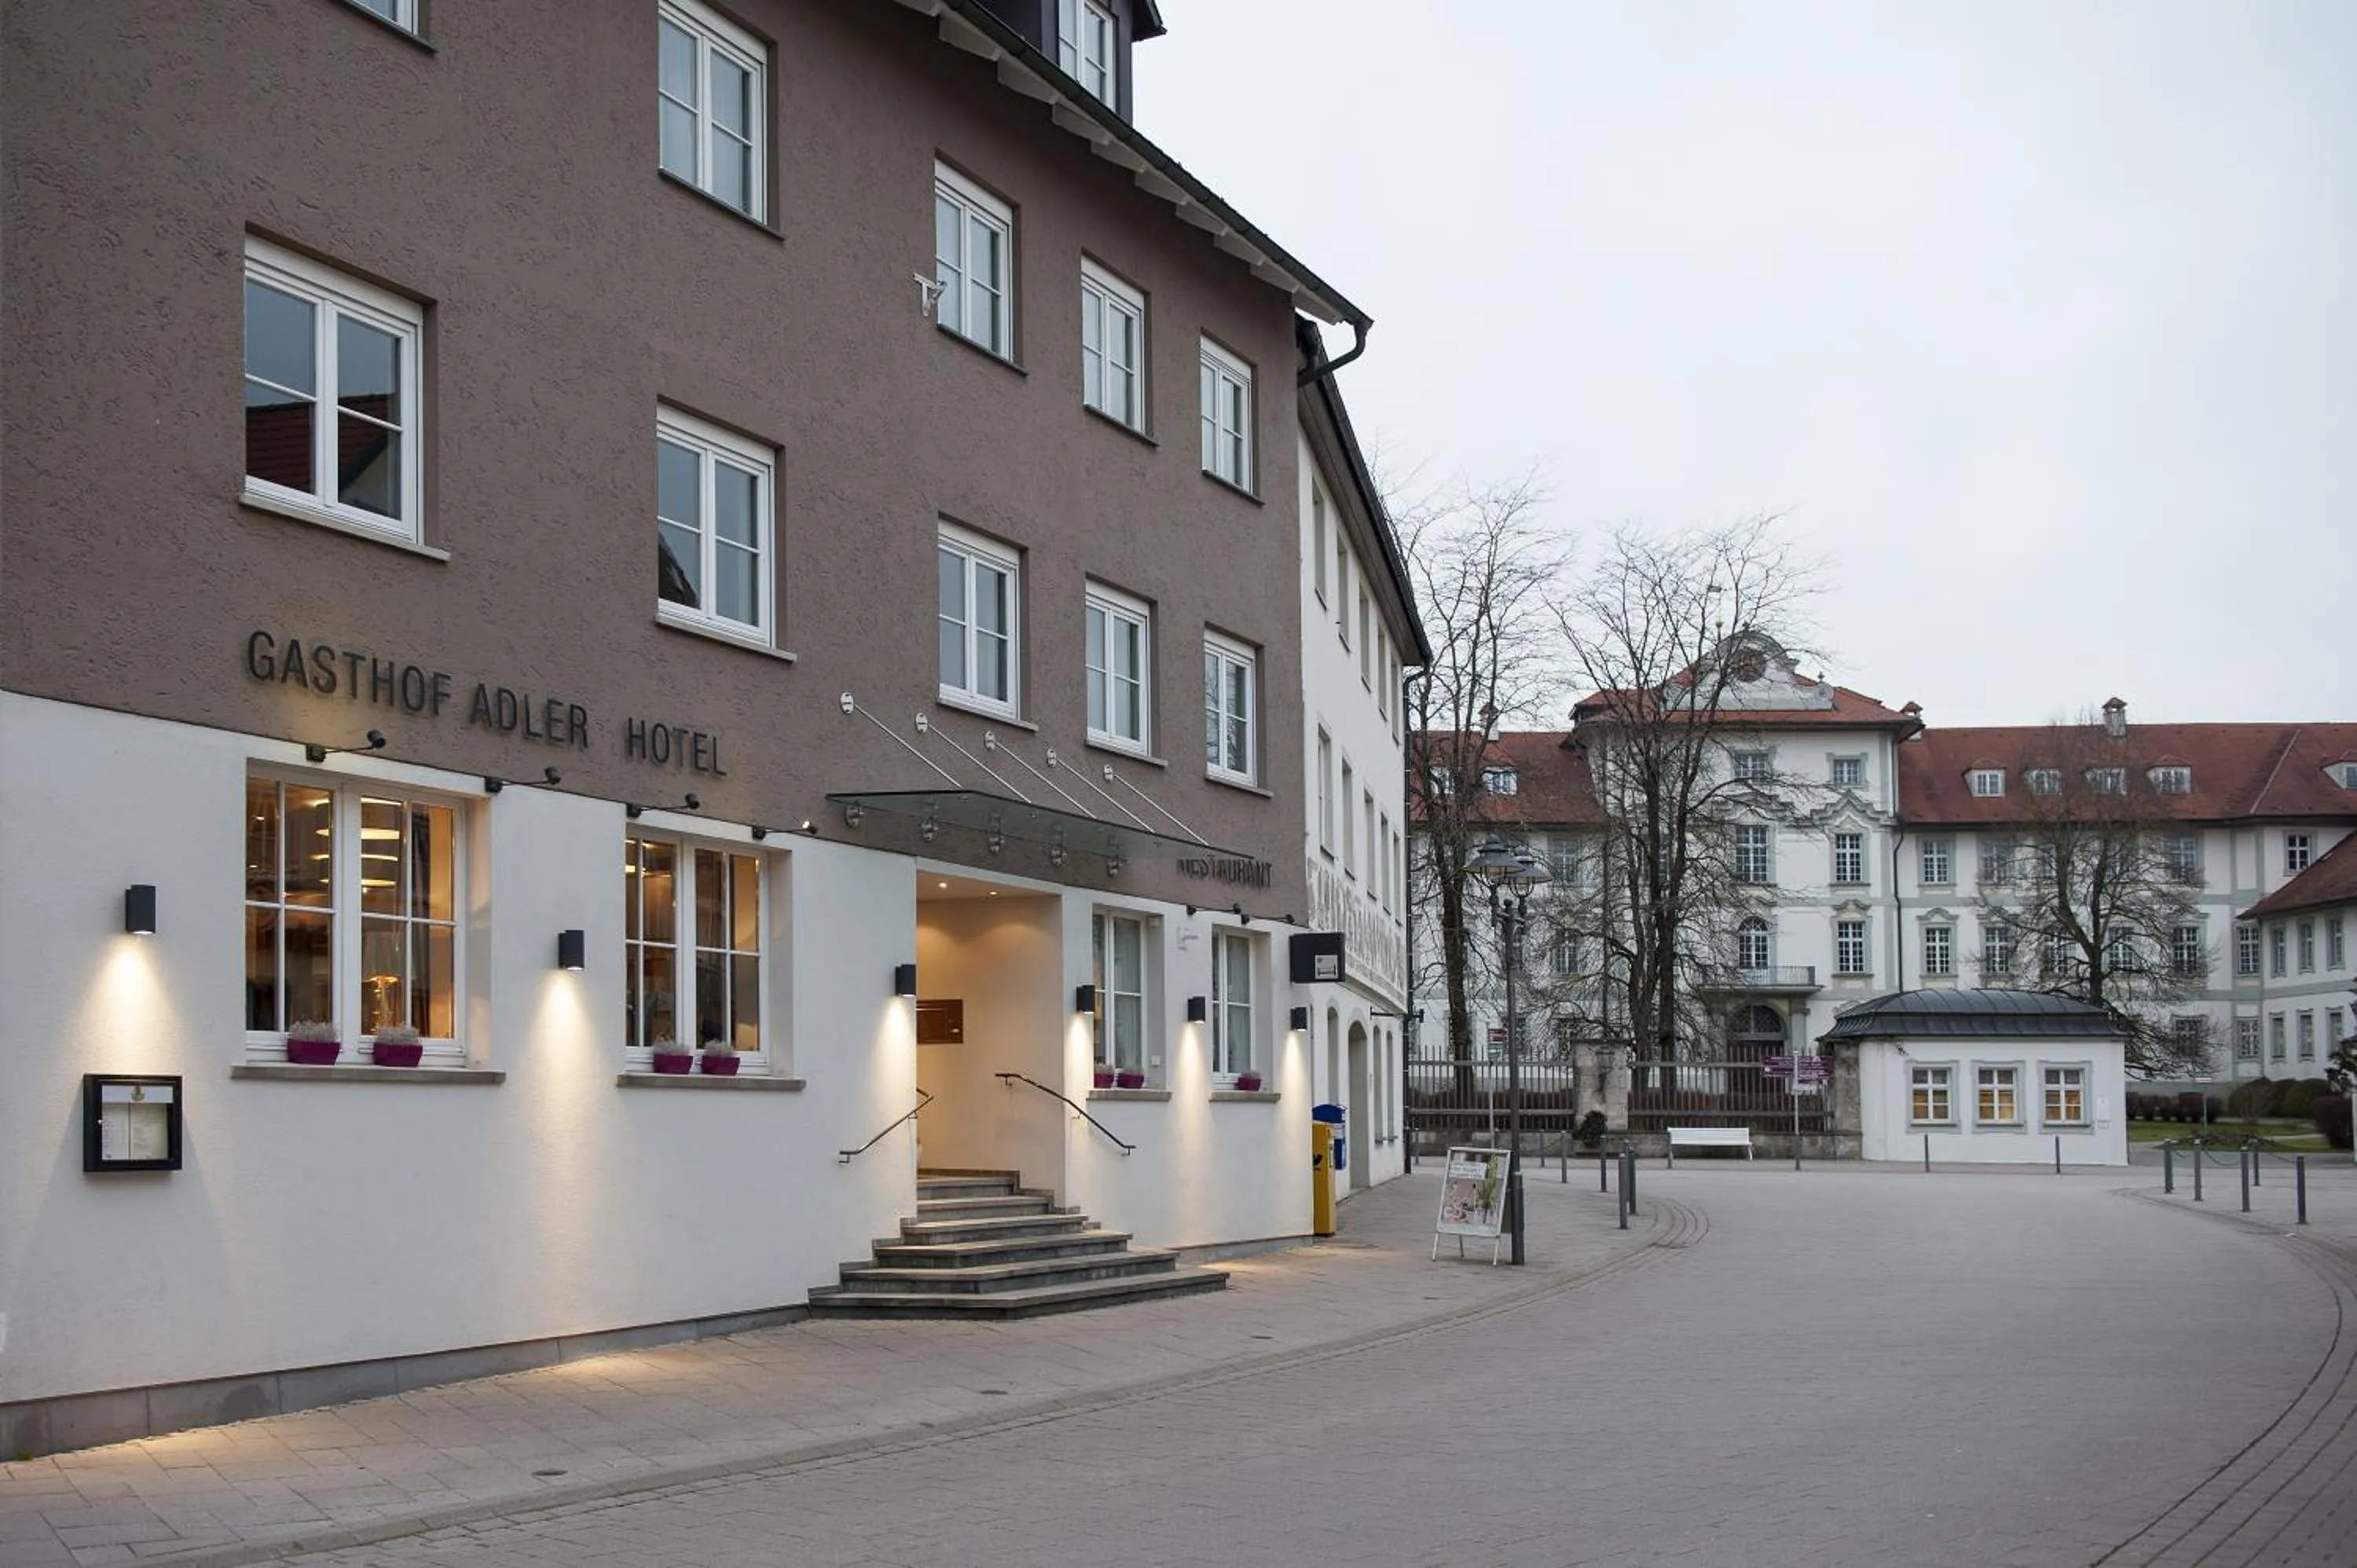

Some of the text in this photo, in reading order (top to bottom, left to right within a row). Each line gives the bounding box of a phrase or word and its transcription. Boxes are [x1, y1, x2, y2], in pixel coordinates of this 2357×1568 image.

[246, 630, 728, 777] GASTHOF ADLER HOTEL
